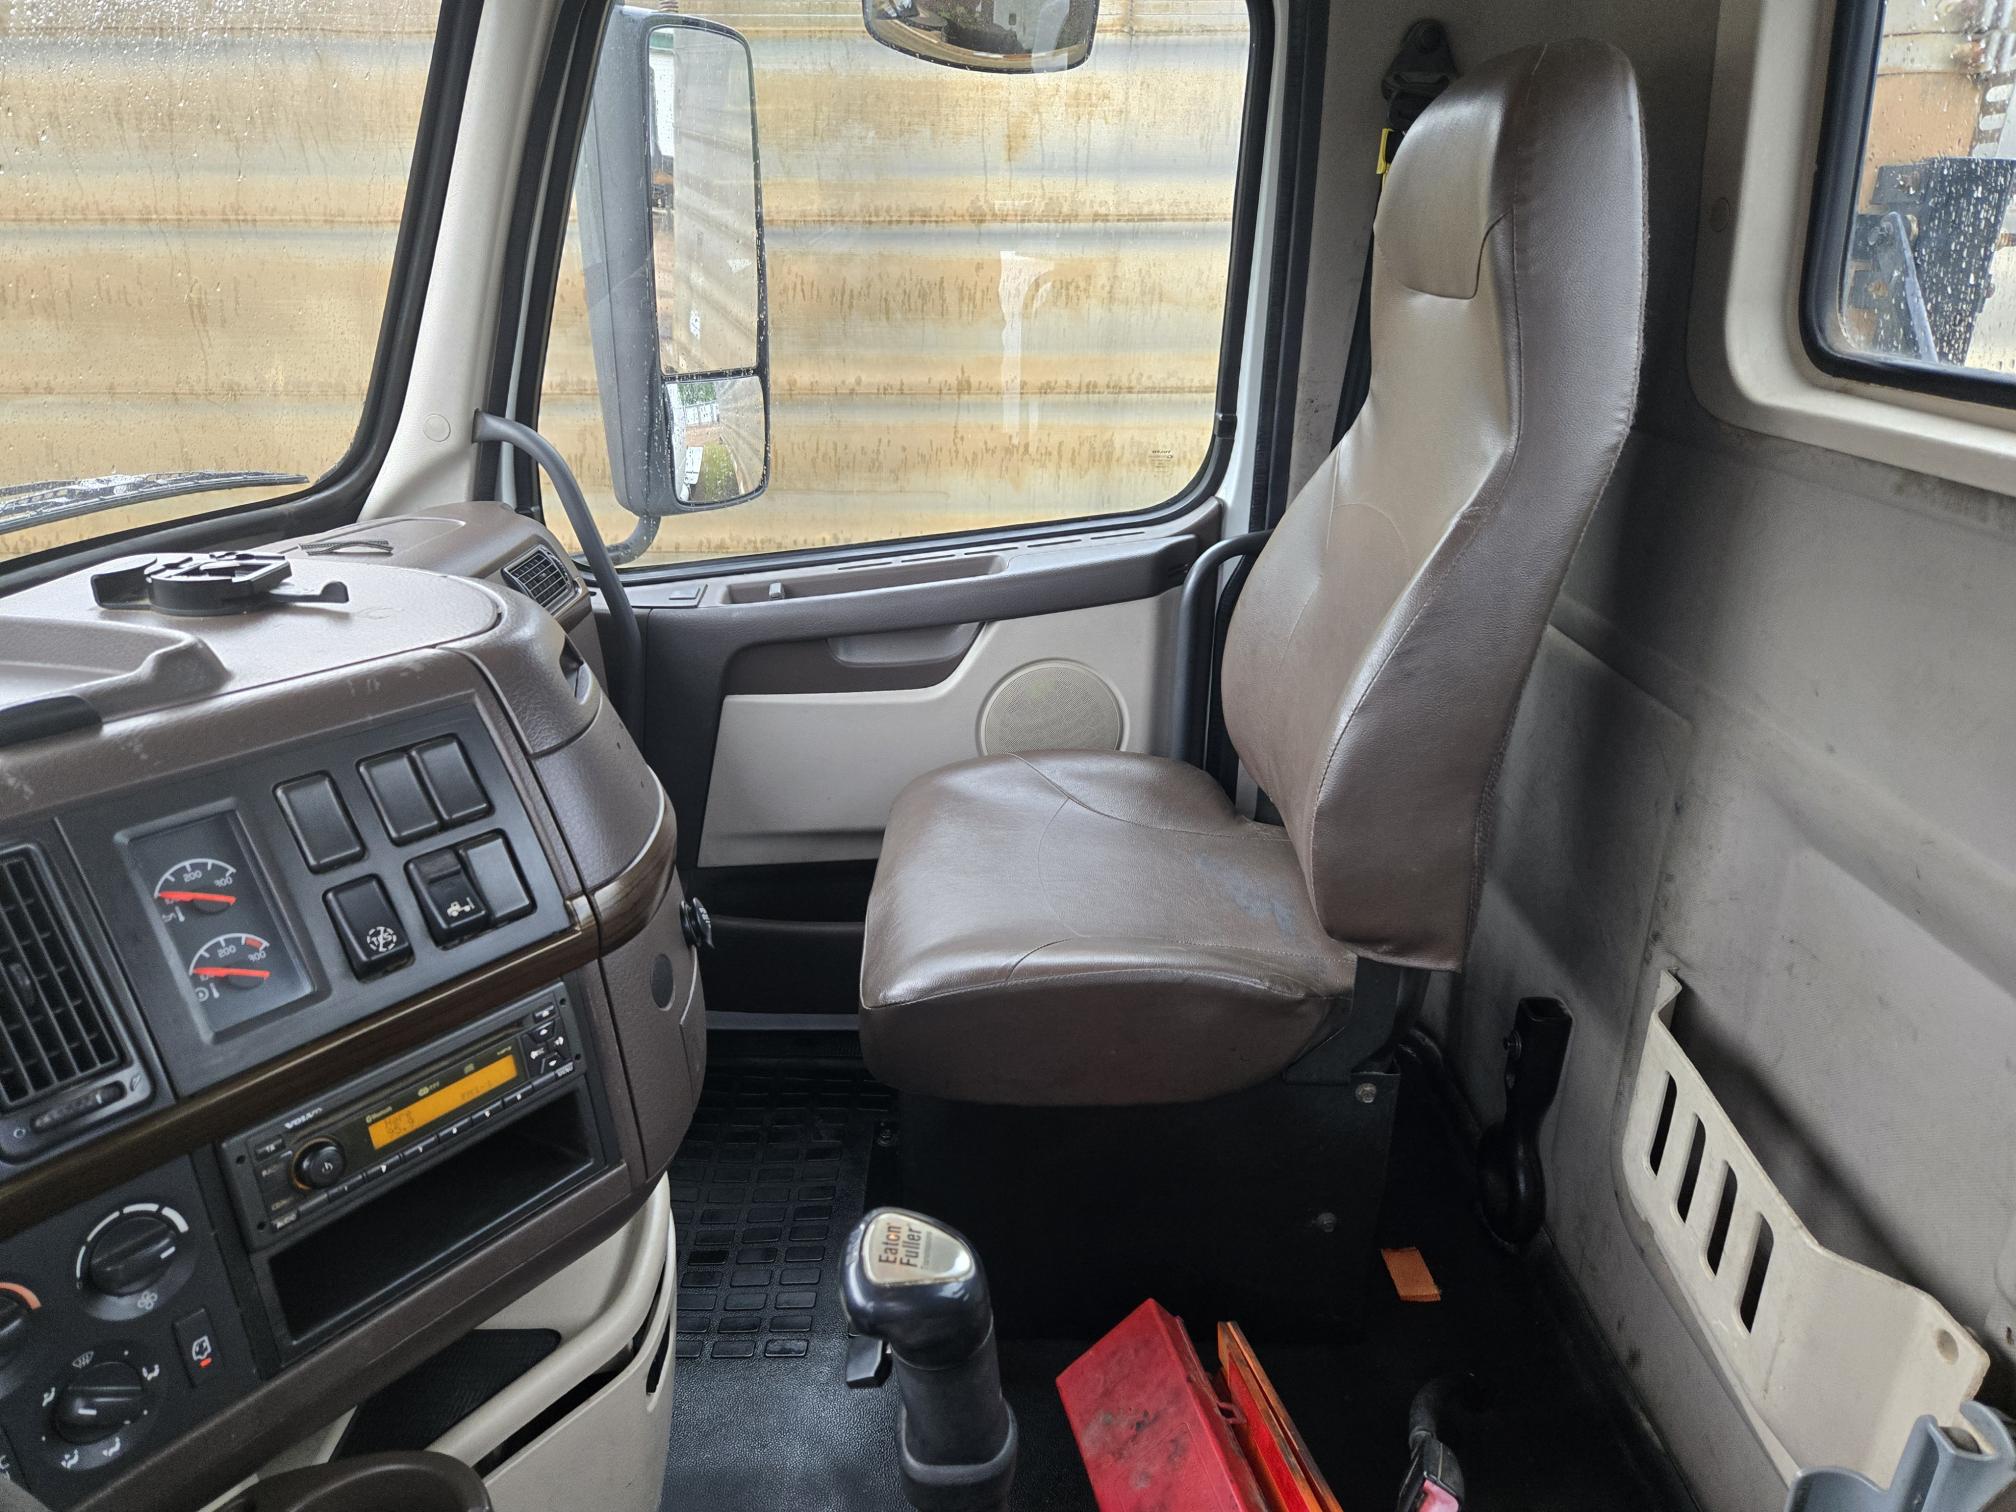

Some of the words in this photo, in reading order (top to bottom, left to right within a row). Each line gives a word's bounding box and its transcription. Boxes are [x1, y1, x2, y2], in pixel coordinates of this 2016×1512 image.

[183, 870, 202, 882] 200
[217, 944, 236, 958] 200
[878, 1225, 902, 1264] Eaton
[900, 1228, 922, 1267] Fuller
